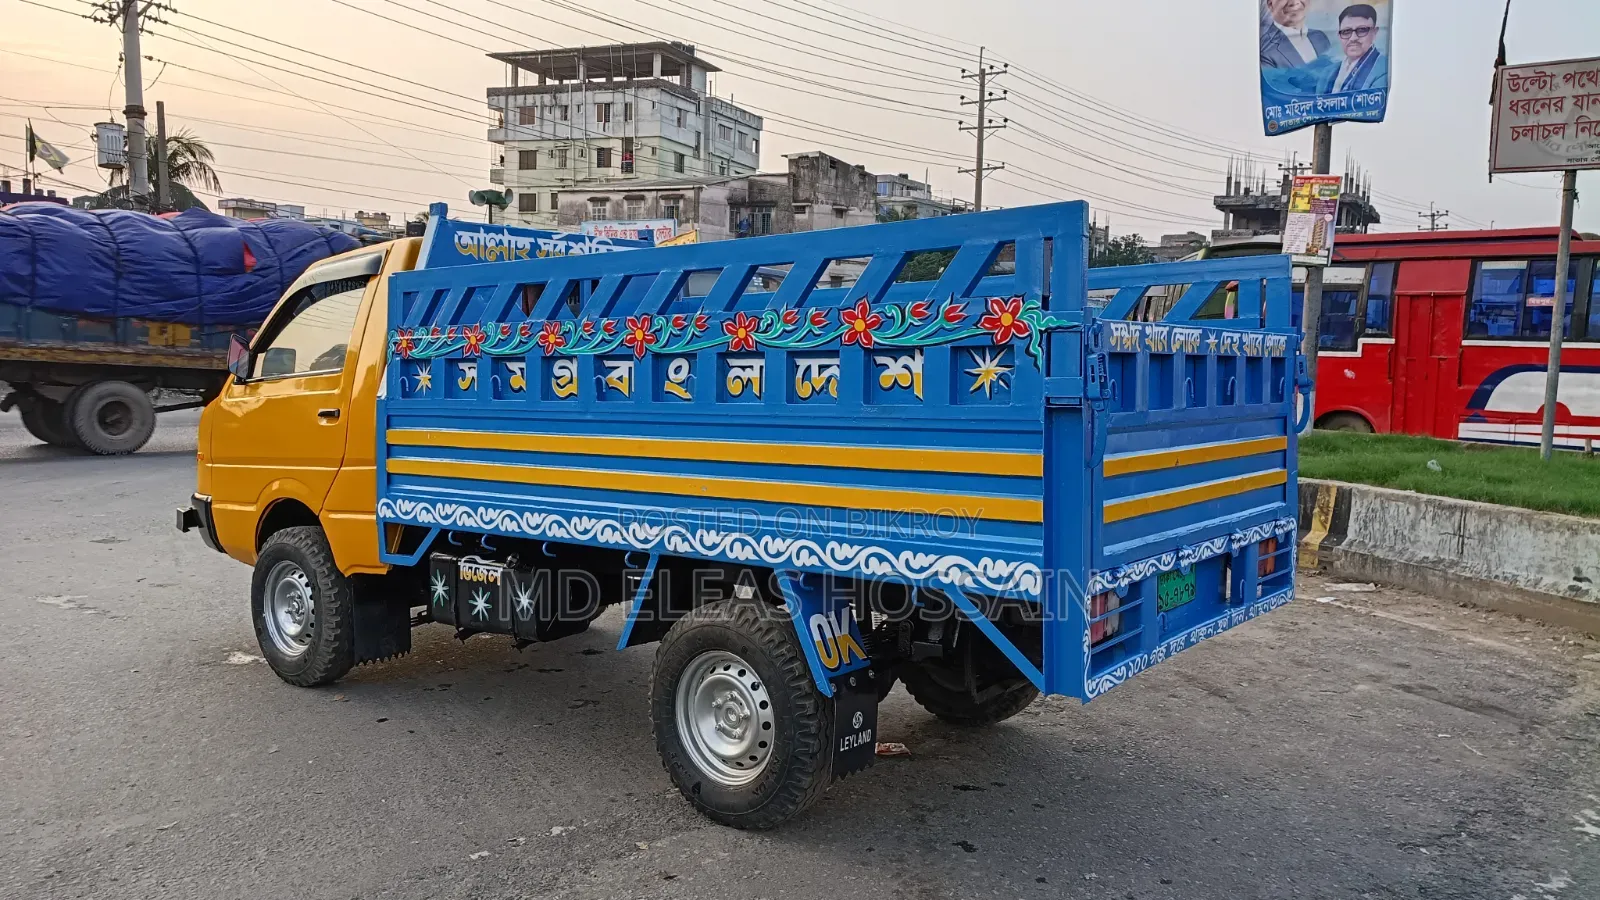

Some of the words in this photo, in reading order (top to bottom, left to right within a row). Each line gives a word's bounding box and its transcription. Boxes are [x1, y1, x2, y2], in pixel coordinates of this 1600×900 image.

[1506, 69, 1556, 92] উল্টো
[1563, 67, 1600, 89] পথে
[1262, 105, 1282, 119] মোঃ
[1316, 96, 1348, 112] ইসলাম
[1351, 89, 1386, 111] (শাওন)
[1509, 96, 1566, 116] ধরনের
[1509, 122, 1568, 141] চলাচল
[454, 227, 535, 262] আল্লাহ
[1145, 324, 1169, 352] খাবে
[1171, 327, 1202, 353] লোকে
[1220, 331, 1241, 356] দেহ
[1242, 332, 1263, 357] খাবে
[458, 555, 504, 586] ডিজেল
[809, 606, 868, 669] OK
[1128, 654, 1148, 678] ১০০
[840, 729, 872, 752] LEYLAND
